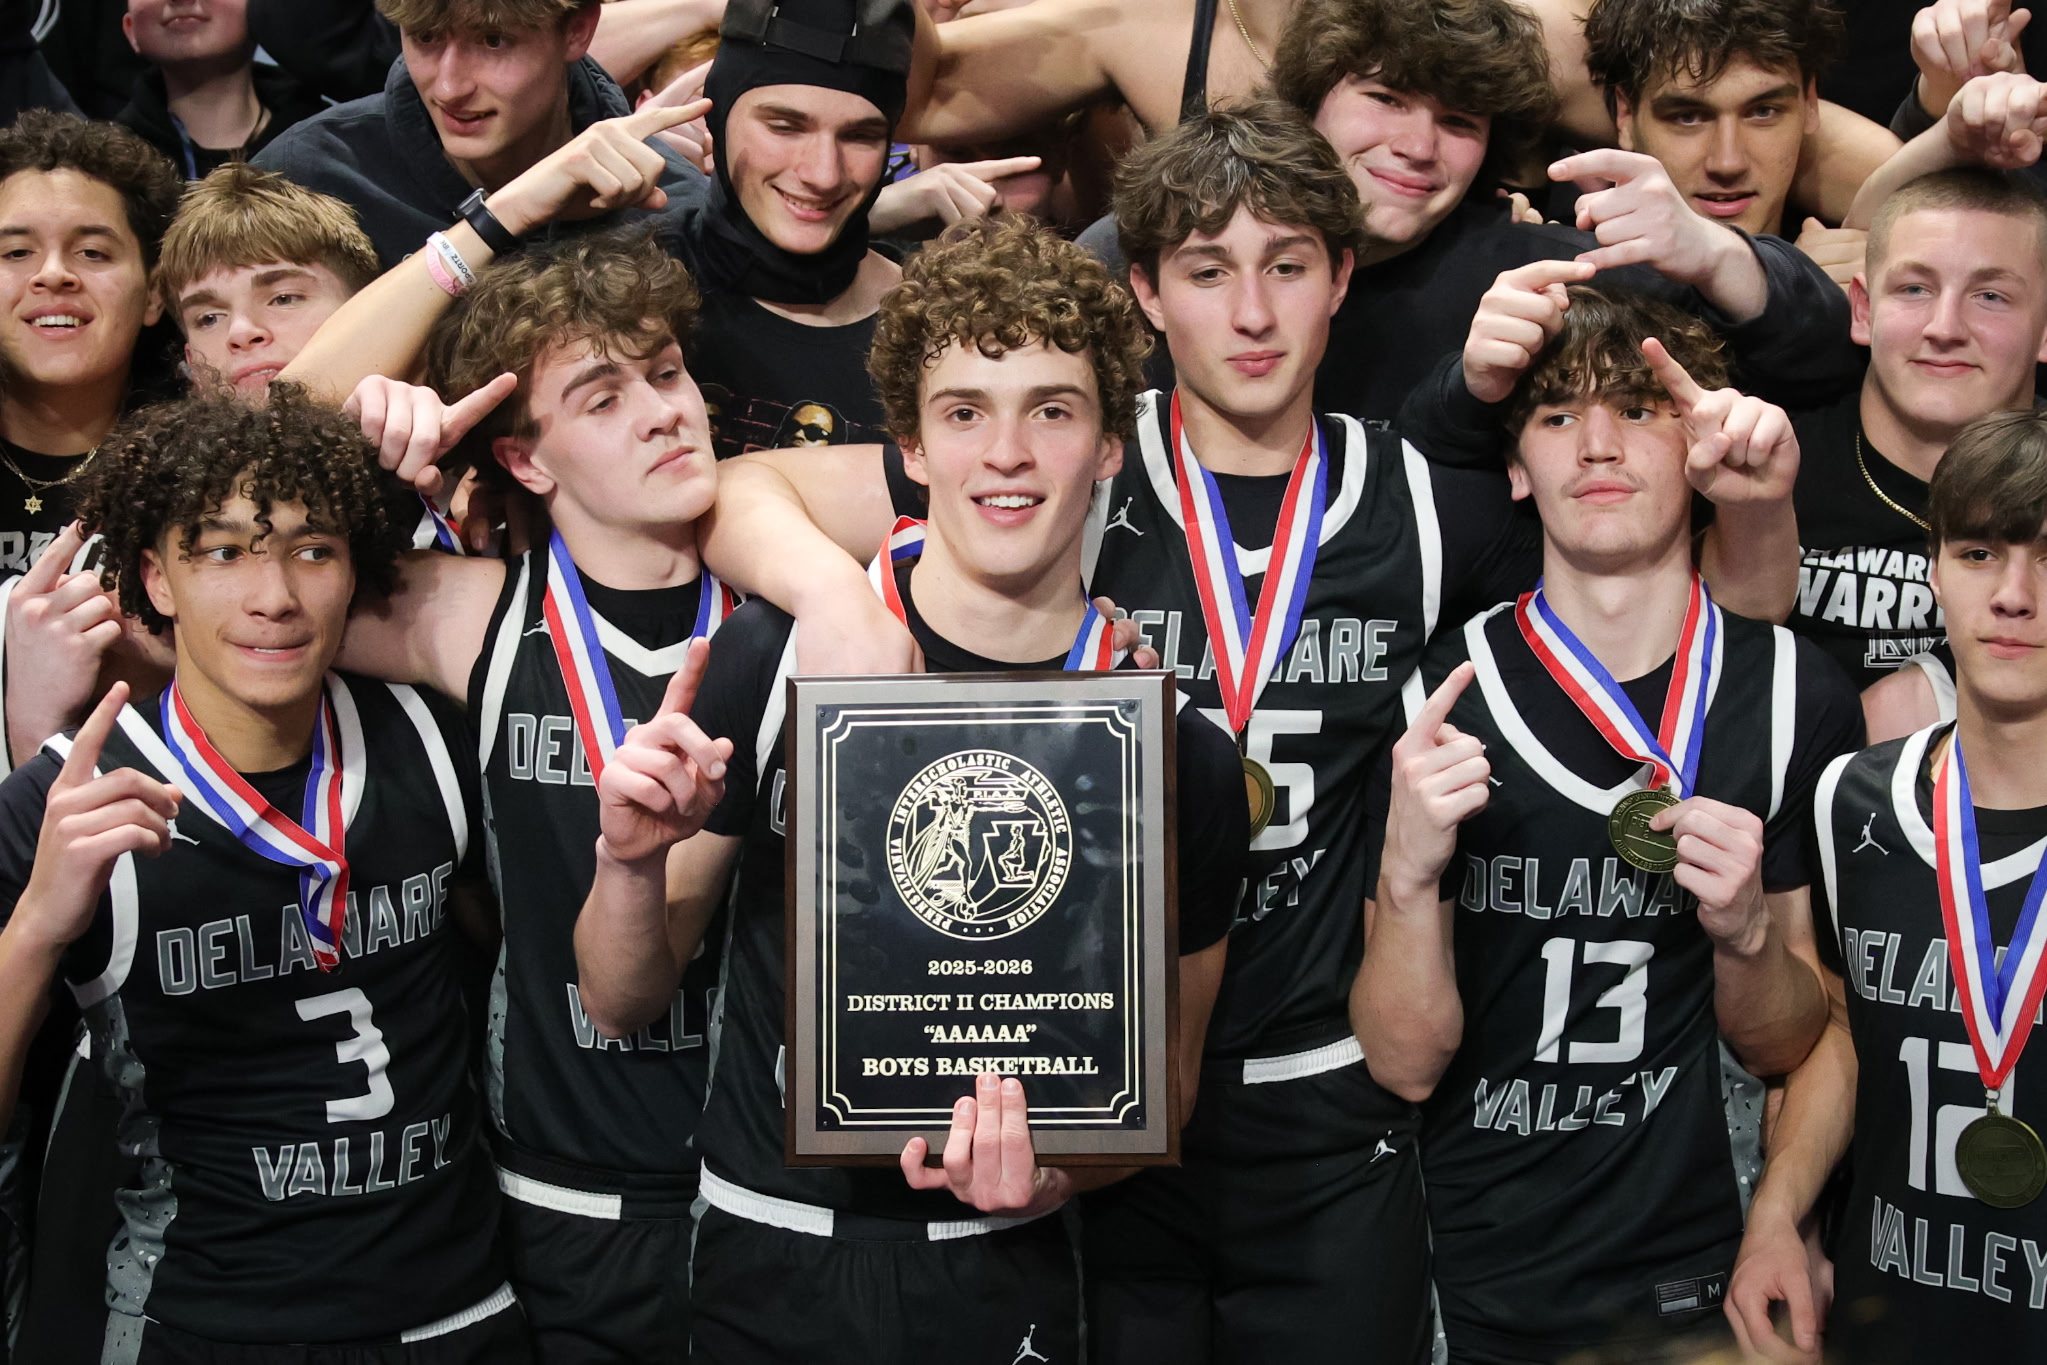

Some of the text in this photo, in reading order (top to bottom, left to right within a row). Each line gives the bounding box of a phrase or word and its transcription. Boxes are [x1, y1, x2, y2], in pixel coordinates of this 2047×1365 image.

[1800, 545, 1932, 582] ELAWAR
[1196, 708, 1323, 852] 5
[890, 754, 1068, 931] PENNSYLVANIA INTERSCHOLASTIC ATHLETIC ASSOCIATION
[1460, 855, 1700, 919] DELAWA
[847, 993, 1114, 1012] DISTRICT II CHAMPIONS
[928, 960, 1033, 976] 2025-2026
[1533, 937, 1655, 1064] 13
[295, 987, 395, 1123] 3
[862, 1057, 1099, 1076] BOYS BASKETBALL
[1473, 1066, 1678, 1136] VALLEY
[1899, 1036, 2015, 1199] 12
[252, 1113, 451, 1201] VALLEY
[1707, 1283, 1721, 1299] M
[1870, 1195, 2047, 1310] VALLEY
